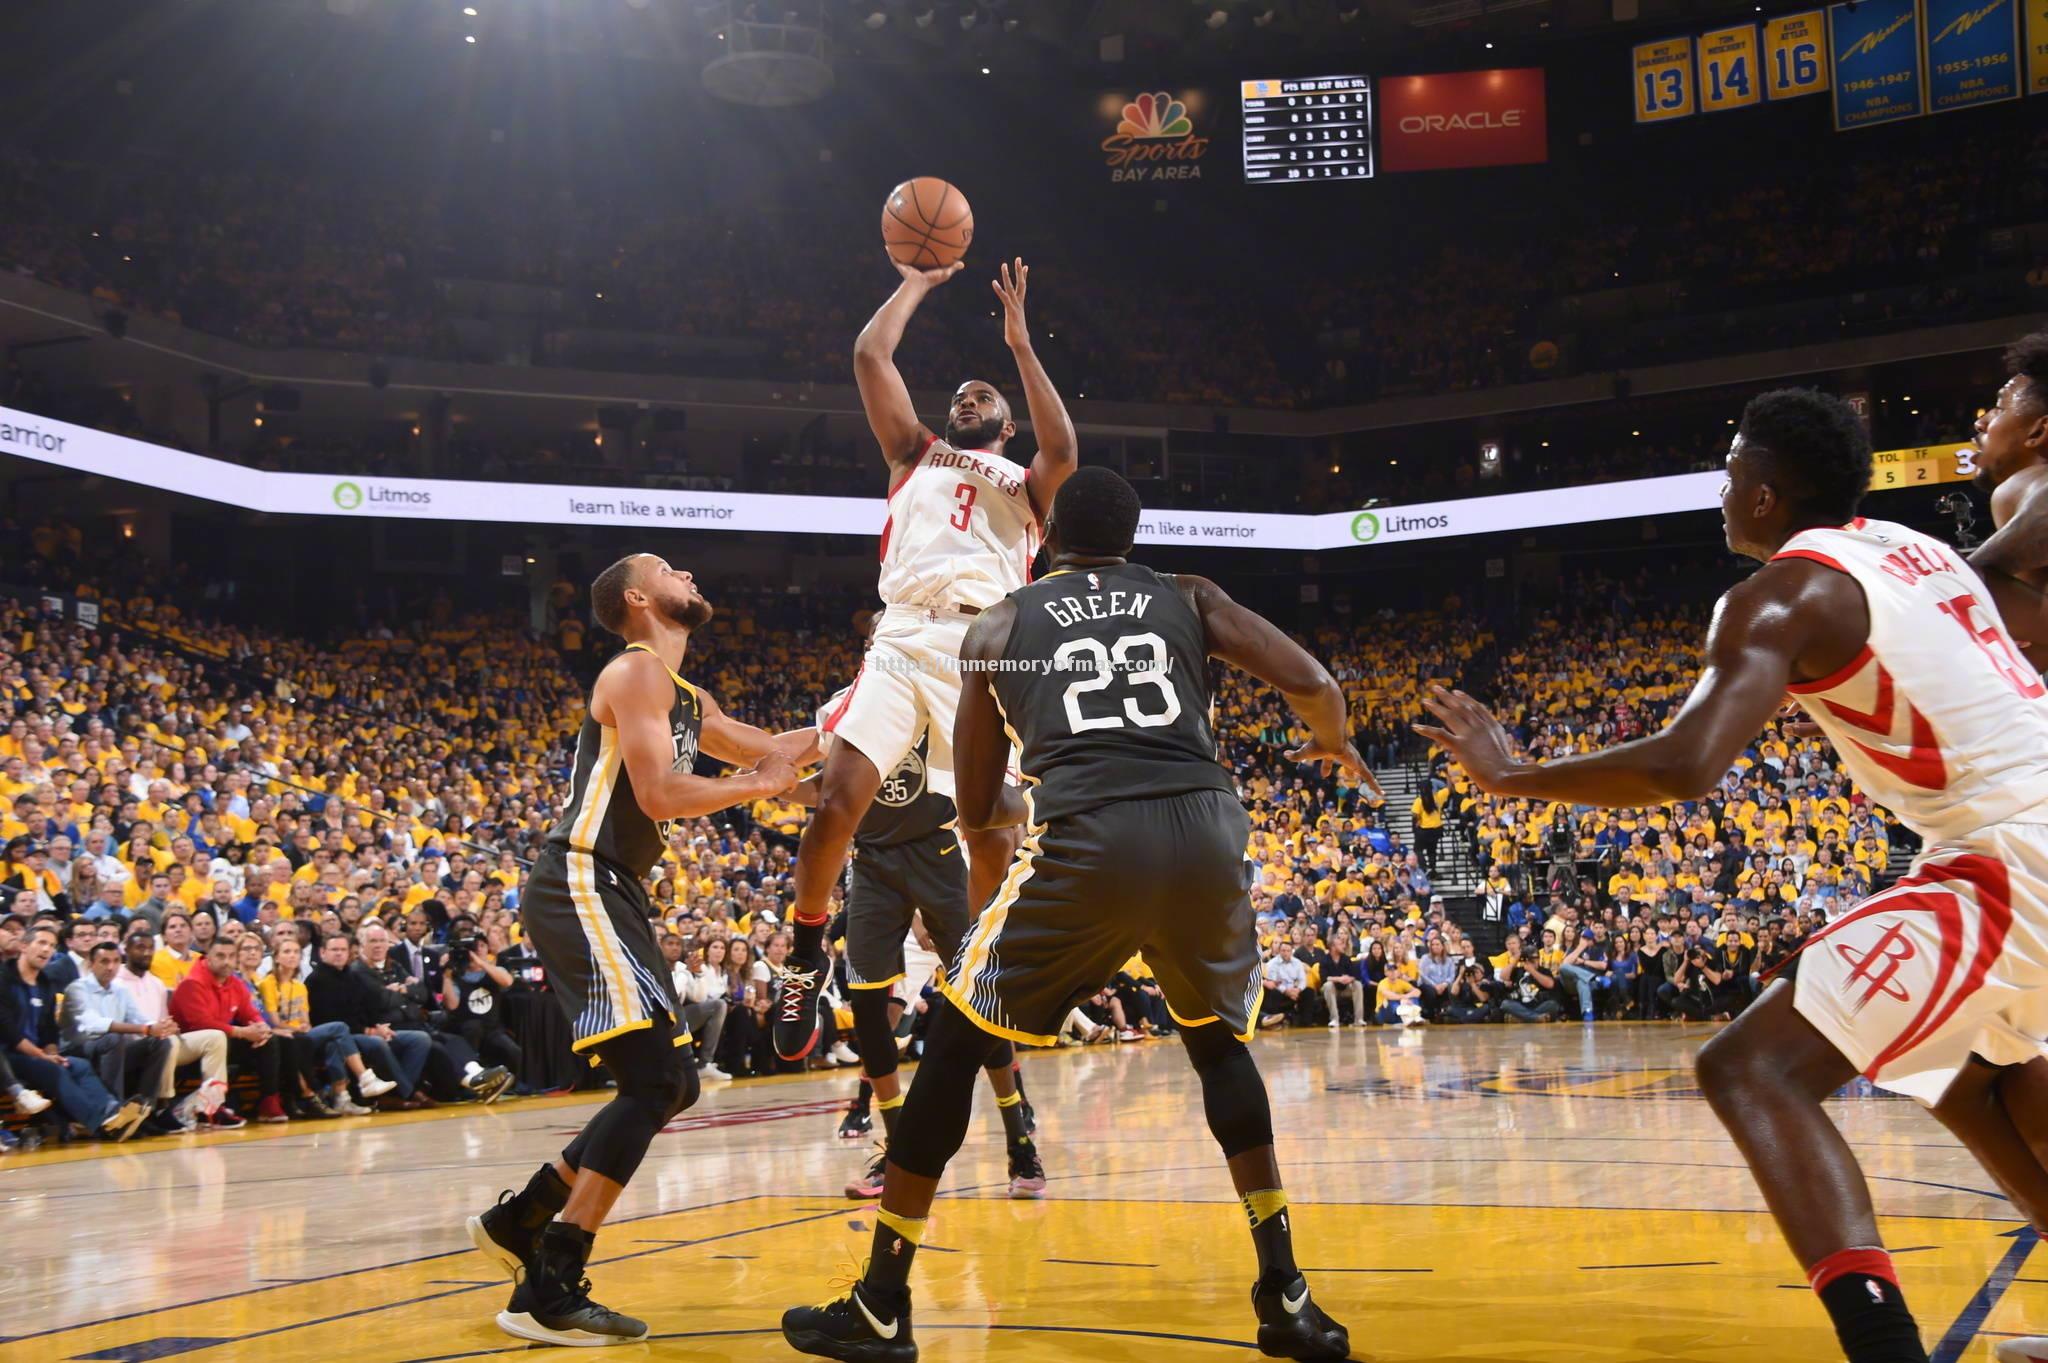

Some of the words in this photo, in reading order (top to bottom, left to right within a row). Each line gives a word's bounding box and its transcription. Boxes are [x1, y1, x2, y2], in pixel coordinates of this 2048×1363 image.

[1776, 43, 1817, 89] 16
[1936, 52, 2009, 75] 1955-1956
[1317, 81, 1332, 89] AST
[1709, 56, 1749, 101] 14
[1843, 71, 1912, 93] 1946-1947
[1959, 78, 1985, 90] NBA
[1644, 68, 1683, 112] 13
[1865, 95, 1889, 107] NBA
[1937, 84, 2010, 106] CHAMPIONS
[1400, 109, 1521, 133] ORACLE
[1845, 103, 1913, 123] CHAMPIONS
[1101, 133, 1209, 168] Sports
[1111, 168, 1148, 182] BAY
[1151, 165, 1201, 180] AREA
[0, 423, 67, 453] arrior
[1914, 449, 1928, 460] TF
[928, 452, 1021, 497] ROCKETS
[1886, 471, 1895, 483] 5
[1917, 468, 1926, 480] 2
[369, 486, 432, 504] Litmos
[569, 498, 615, 515] learn
[620, 500, 650, 516] like
[655, 505, 666, 517] a
[671, 504, 735, 519] warrior
[950, 482, 978, 533] 3
[1158, 521, 1185, 536] like
[1189, 525, 1198, 536] a
[1201, 524, 1256, 538] warrior
[1385, 515, 1449, 533] Litmos
[1044, 591, 1153, 628] GREEN
[1053, 631, 1183, 735] 23
[883, 779, 908, 802] 35
